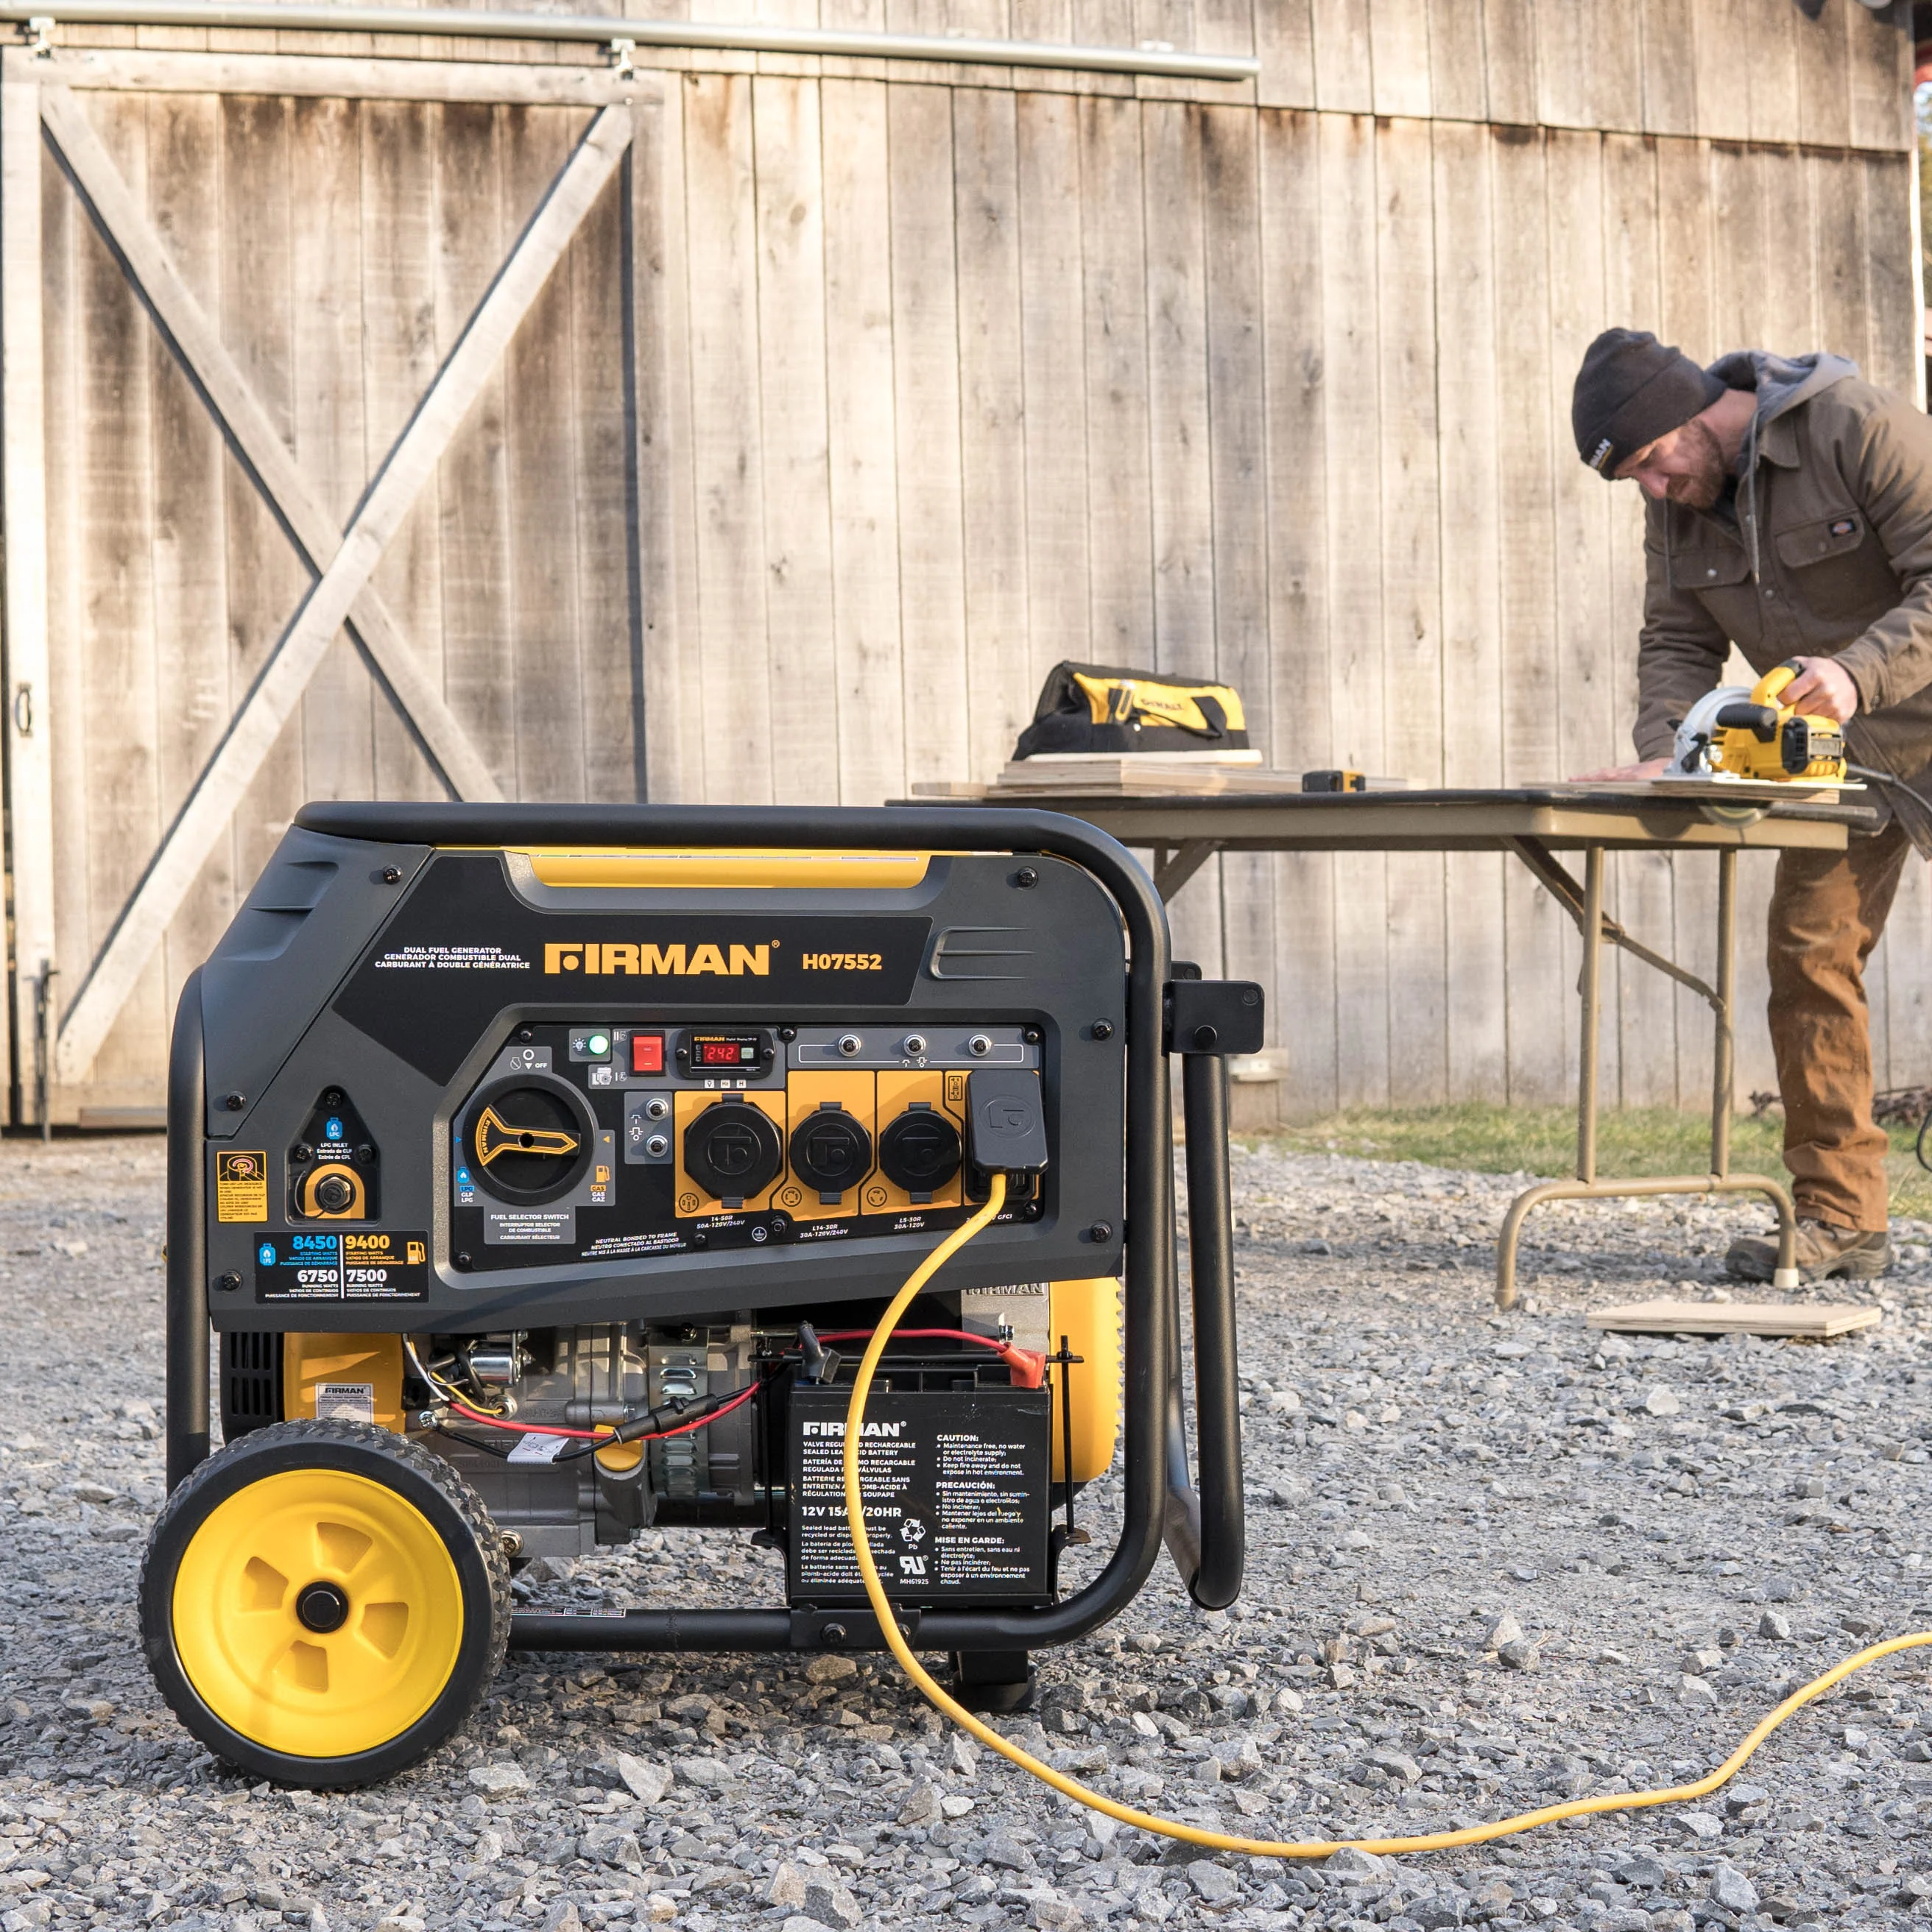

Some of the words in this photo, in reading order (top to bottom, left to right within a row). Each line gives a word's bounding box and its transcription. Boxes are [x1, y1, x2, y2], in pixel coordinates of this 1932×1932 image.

[429, 960, 436, 968] À
[473, 961, 530, 969] GÉNÉRATRICE
[803, 953, 882, 970] H07552
[292, 1235, 337, 1249] 8450
[345, 1235, 390, 1249] 9400
[297, 1269, 338, 1282] 6750
[346, 1269, 387, 1282] 7500
[936, 1481, 995, 1489] PRECAUCIÓN:
[802, 1506, 825, 1516] 12V
[829, 1506, 902, 1517] 15A/20HR
